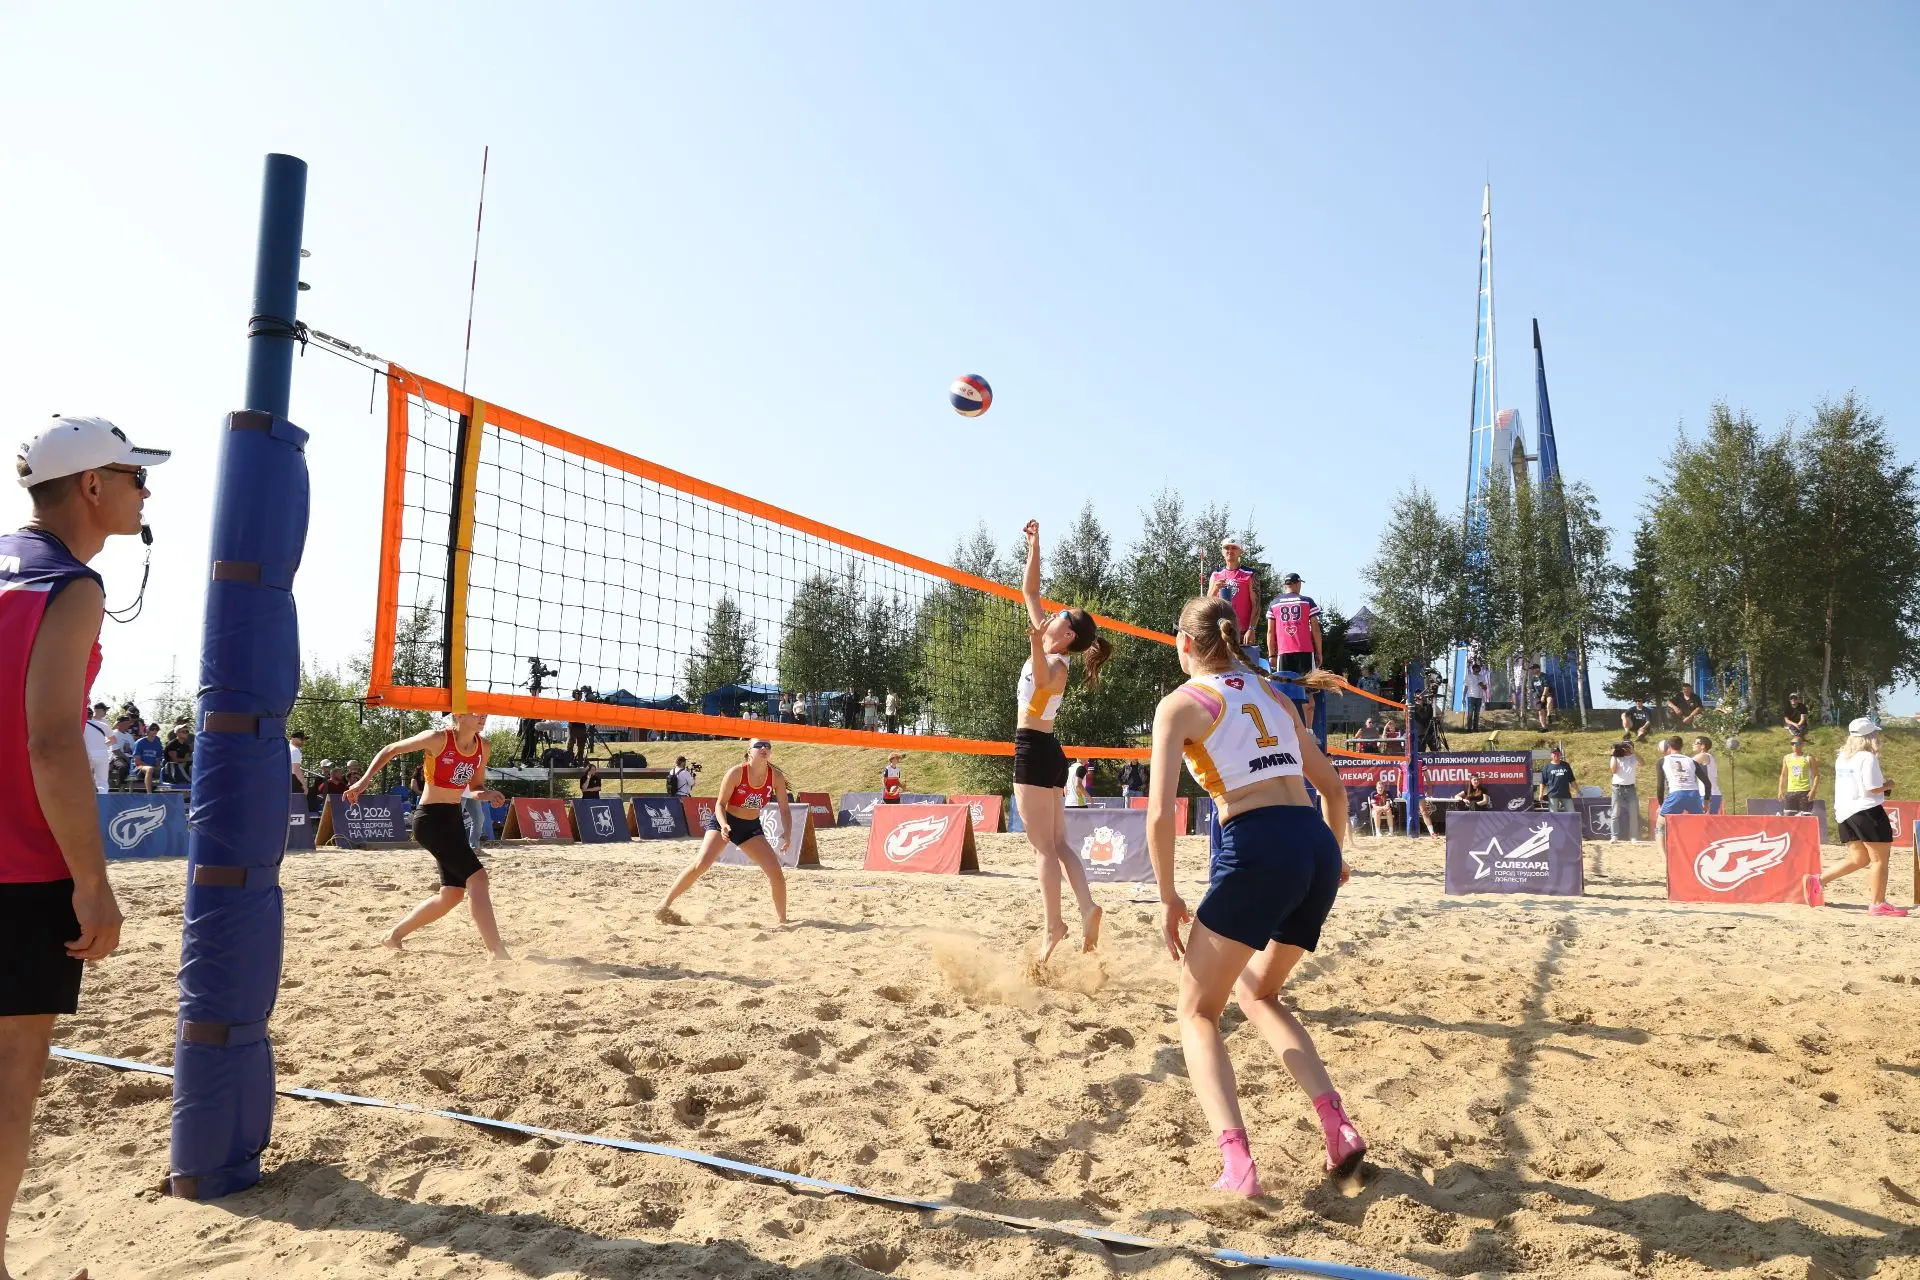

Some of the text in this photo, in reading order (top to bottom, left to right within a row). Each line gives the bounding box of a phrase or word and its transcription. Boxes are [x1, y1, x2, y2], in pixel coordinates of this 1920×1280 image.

[1280, 604, 1301, 622] 89
[1242, 704, 1278, 748] 1
[1435, 756, 1478, 764] ПЛЯЖНОМУ
[1479, 755, 1526, 763] ВОЛЕЙБОЛУ
[1340, 773, 1374, 781] ЛЕХАРД
[1380, 769, 1396, 782] 66
[766, 785, 773, 797] 2
[363, 807, 391, 818] 2026
[349, 829, 395, 838] НА ЯМАЛЕ
[1494, 861, 1550, 870] САЛЕХАРД
